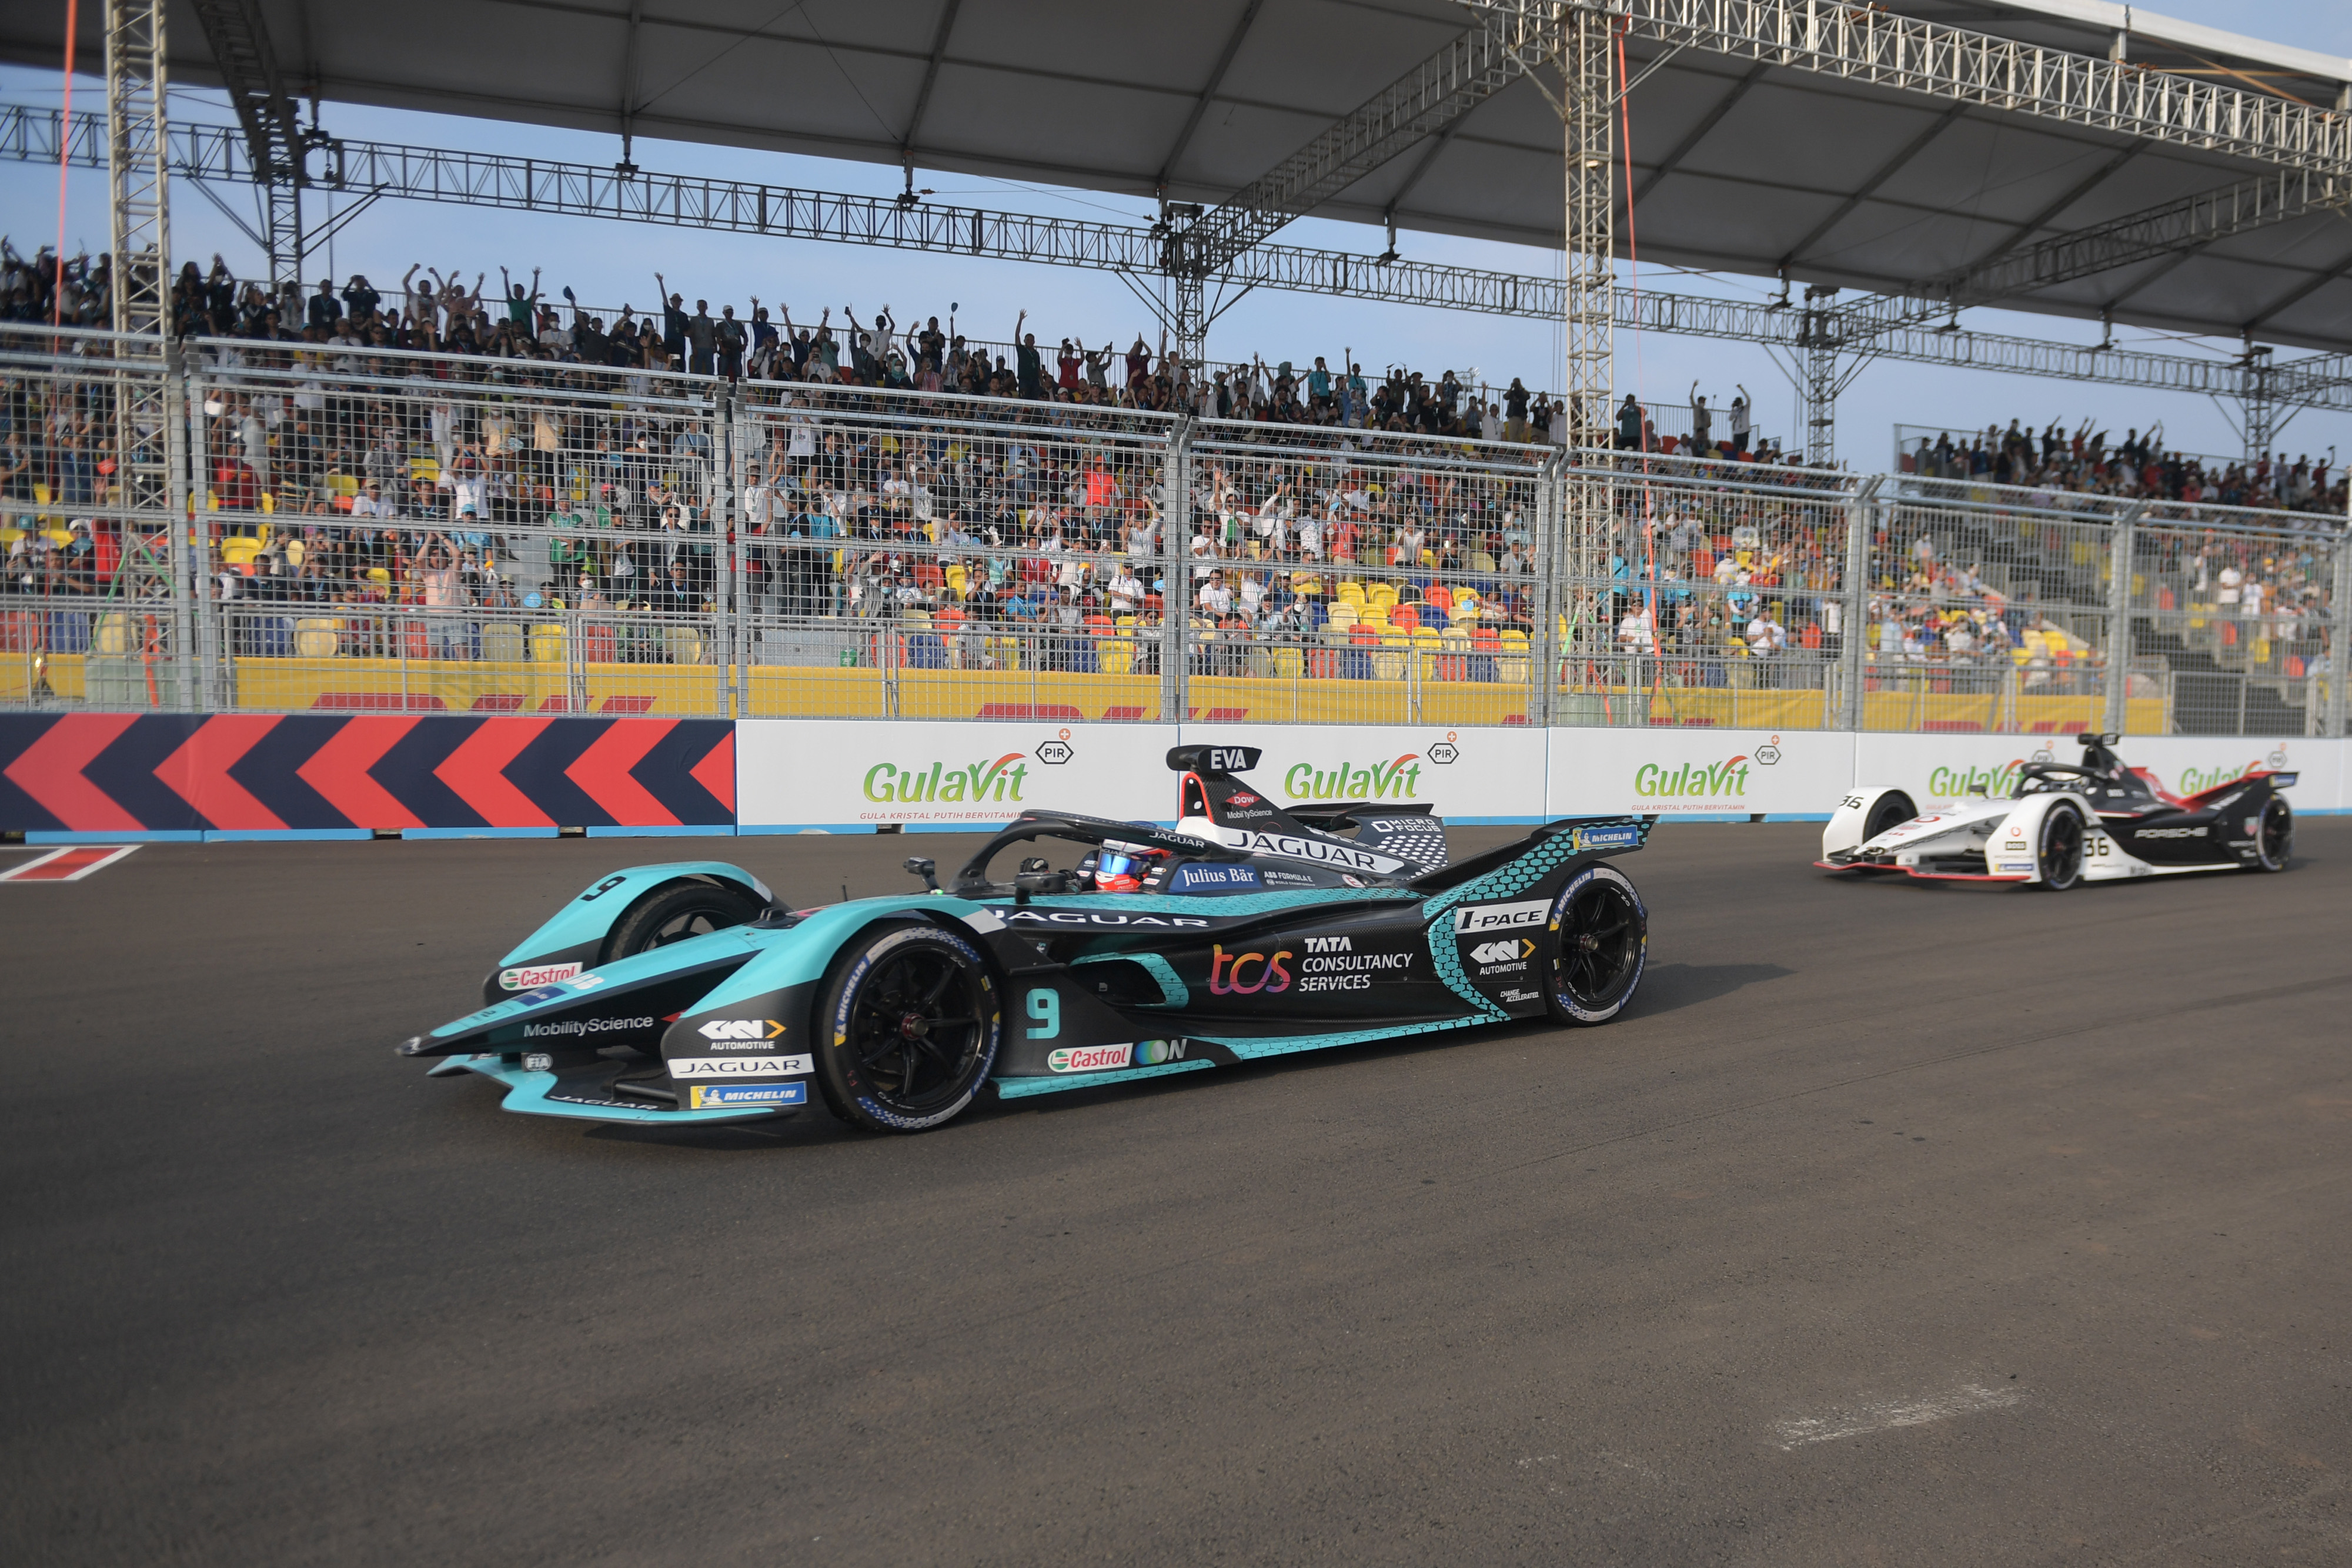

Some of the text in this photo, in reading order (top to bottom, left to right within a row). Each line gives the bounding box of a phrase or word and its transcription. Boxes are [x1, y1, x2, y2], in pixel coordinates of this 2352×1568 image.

[1045, 748, 1065, 758] PIR
[1211, 749, 1247, 769] EVA
[1435, 749, 1452, 758] PIR
[1760, 751, 1775, 760] PIR
[863, 753, 1028, 803] GulaVit
[1285, 754, 1421, 799] GulaVit
[1635, 755, 1749, 797] GulaVit
[1839, 795, 1864, 810] 36
[1149, 831, 1205, 848] JAGUAR
[1591, 832, 1632, 842] MICHELIN
[2134, 827, 2208, 838] PORSCHE
[1227, 832, 1377, 871] JAGUAR
[2084, 837, 2109, 857] 36
[1182, 868, 1227, 886] Julius
[1229, 868, 1254, 882] Bär
[1278, 872, 1306, 881] FORMULA
[580, 876, 627, 901] 9
[1558, 872, 1591, 911] MICHELIN
[1460, 911, 1543, 930] I-PACE
[1304, 937, 1352, 952] TATA
[1210, 944, 1292, 995] tcs
[1302, 953, 1413, 972] CONSULTANCY
[1479, 962, 1527, 975] AUTOMOTIVE
[838, 961, 867, 1021] MICHELIN
[1298, 974, 1371, 992] SERVICES
[1026, 988, 1060, 1039] 9
[524, 1016, 653, 1037] MobilityScience
[710, 1041, 775, 1050] AUTOMOTIVE
[679, 1059, 800, 1074] JAGUAR
[1071, 1048, 1126, 1068] Castrol
[550, 1095, 659, 1110] JAGUAR
[724, 1089, 797, 1101] MICHELIN
